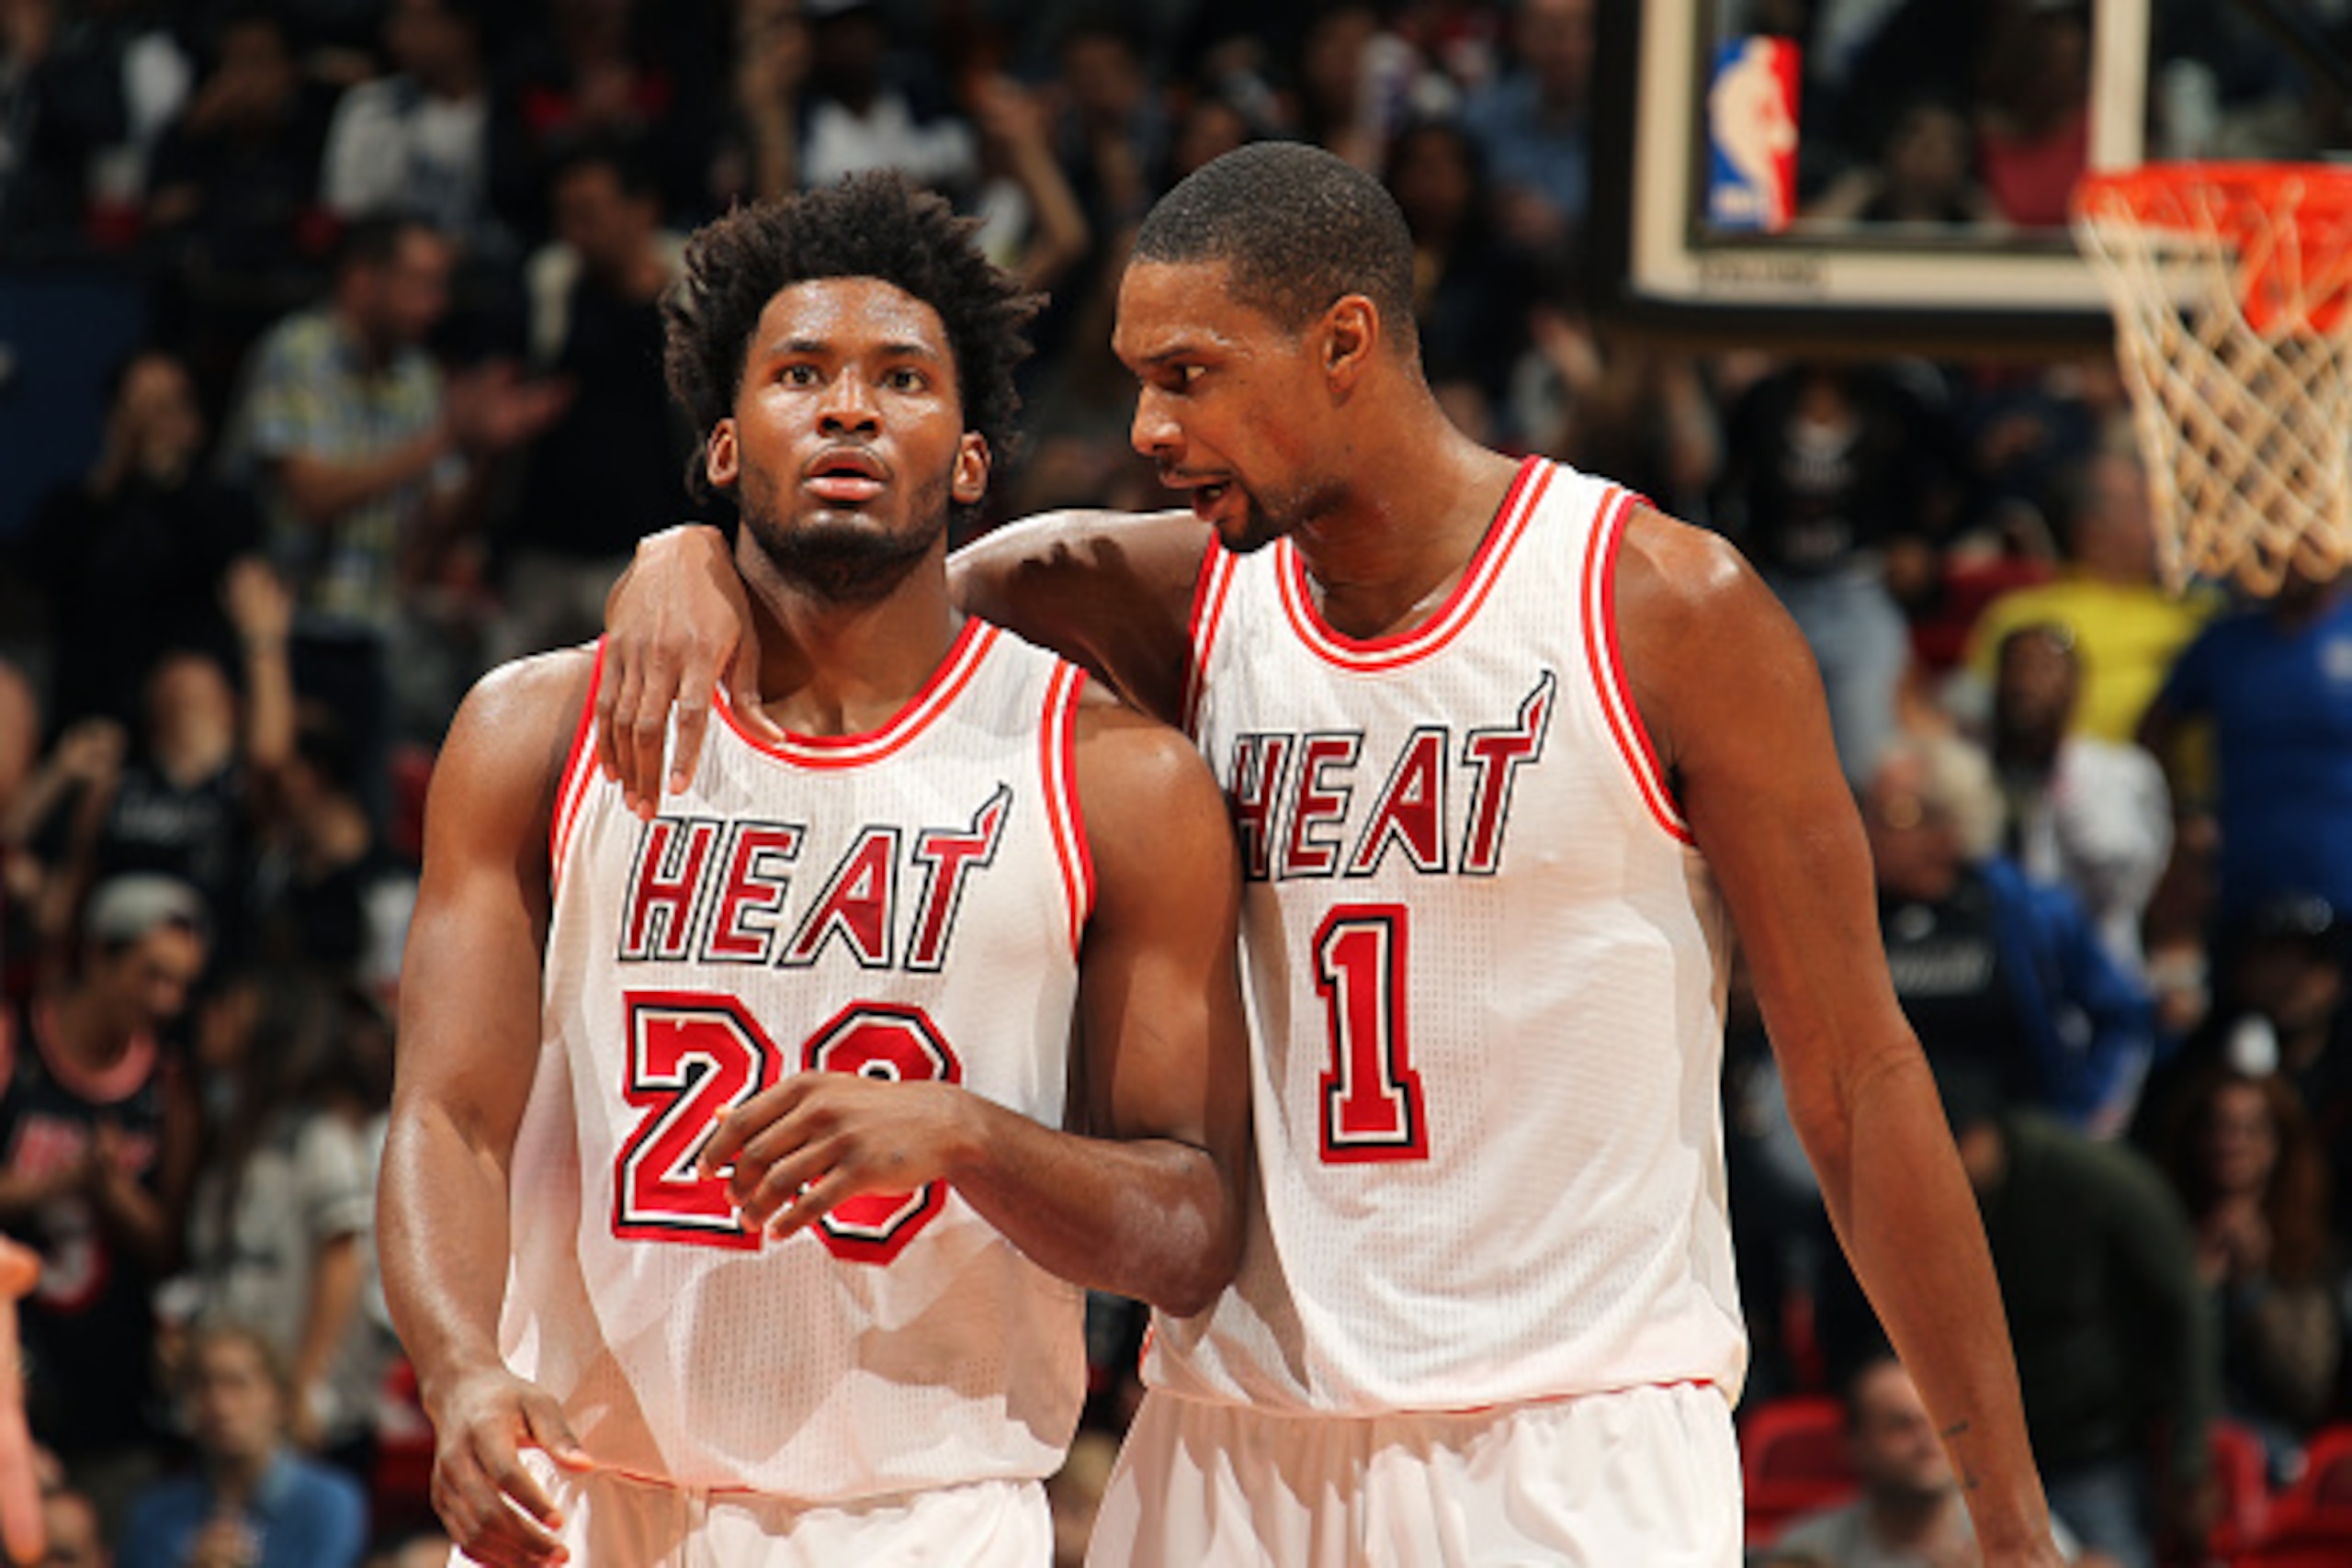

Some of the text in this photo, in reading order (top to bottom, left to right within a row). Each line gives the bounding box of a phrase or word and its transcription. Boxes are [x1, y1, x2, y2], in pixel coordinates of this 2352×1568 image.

[618, 780, 1013, 974] HEAT
[1230, 669, 1556, 882] HEAT
[1311, 903, 1430, 1164] 1
